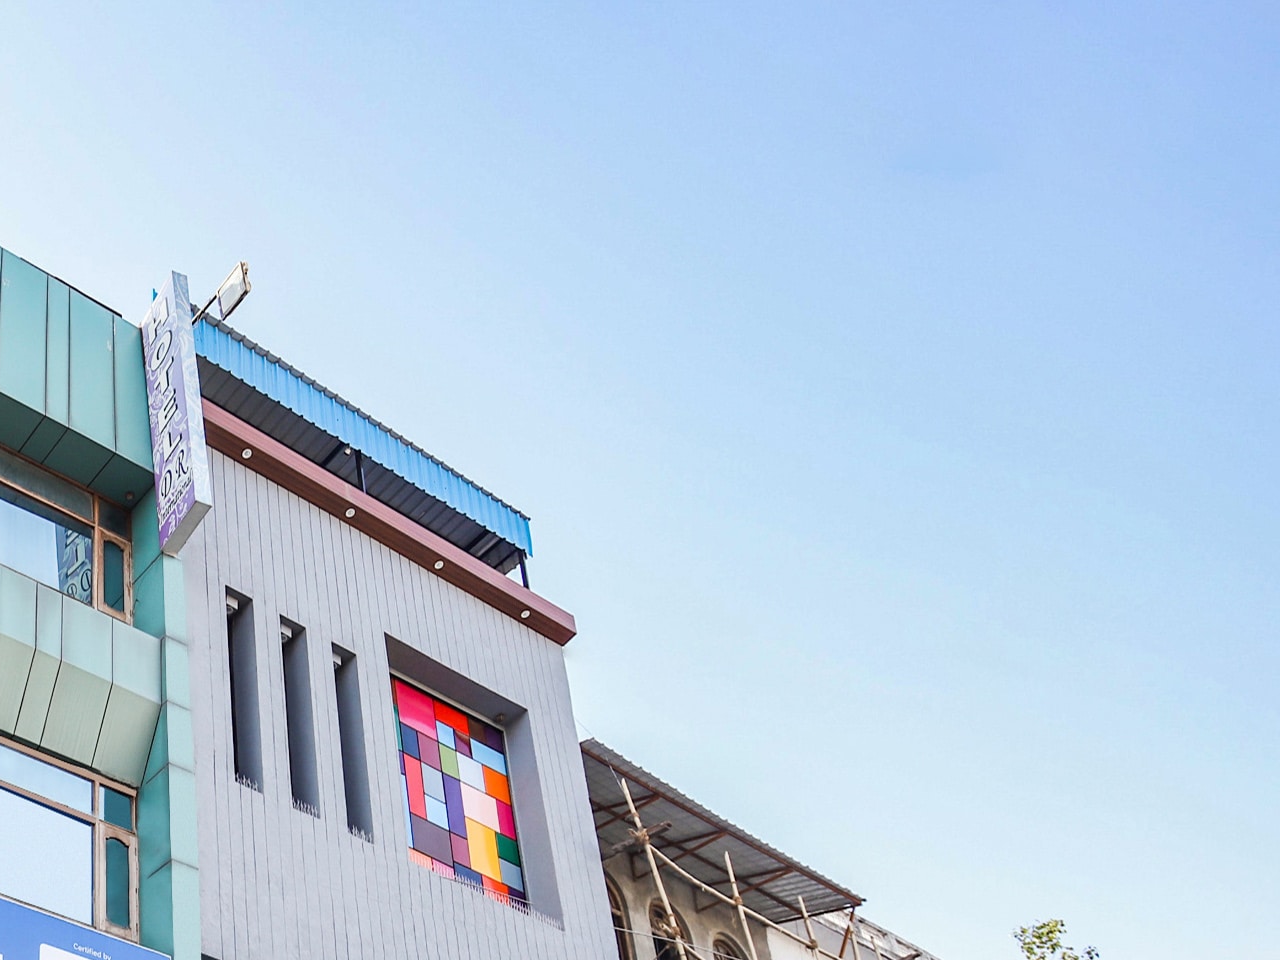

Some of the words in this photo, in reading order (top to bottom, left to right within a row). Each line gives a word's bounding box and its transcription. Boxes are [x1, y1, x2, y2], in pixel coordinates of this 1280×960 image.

[147, 295, 183, 464] HOTEL
[160, 468, 173, 499] D
[174, 449, 190, 480] R
[73, 942, 102, 959] Certified
